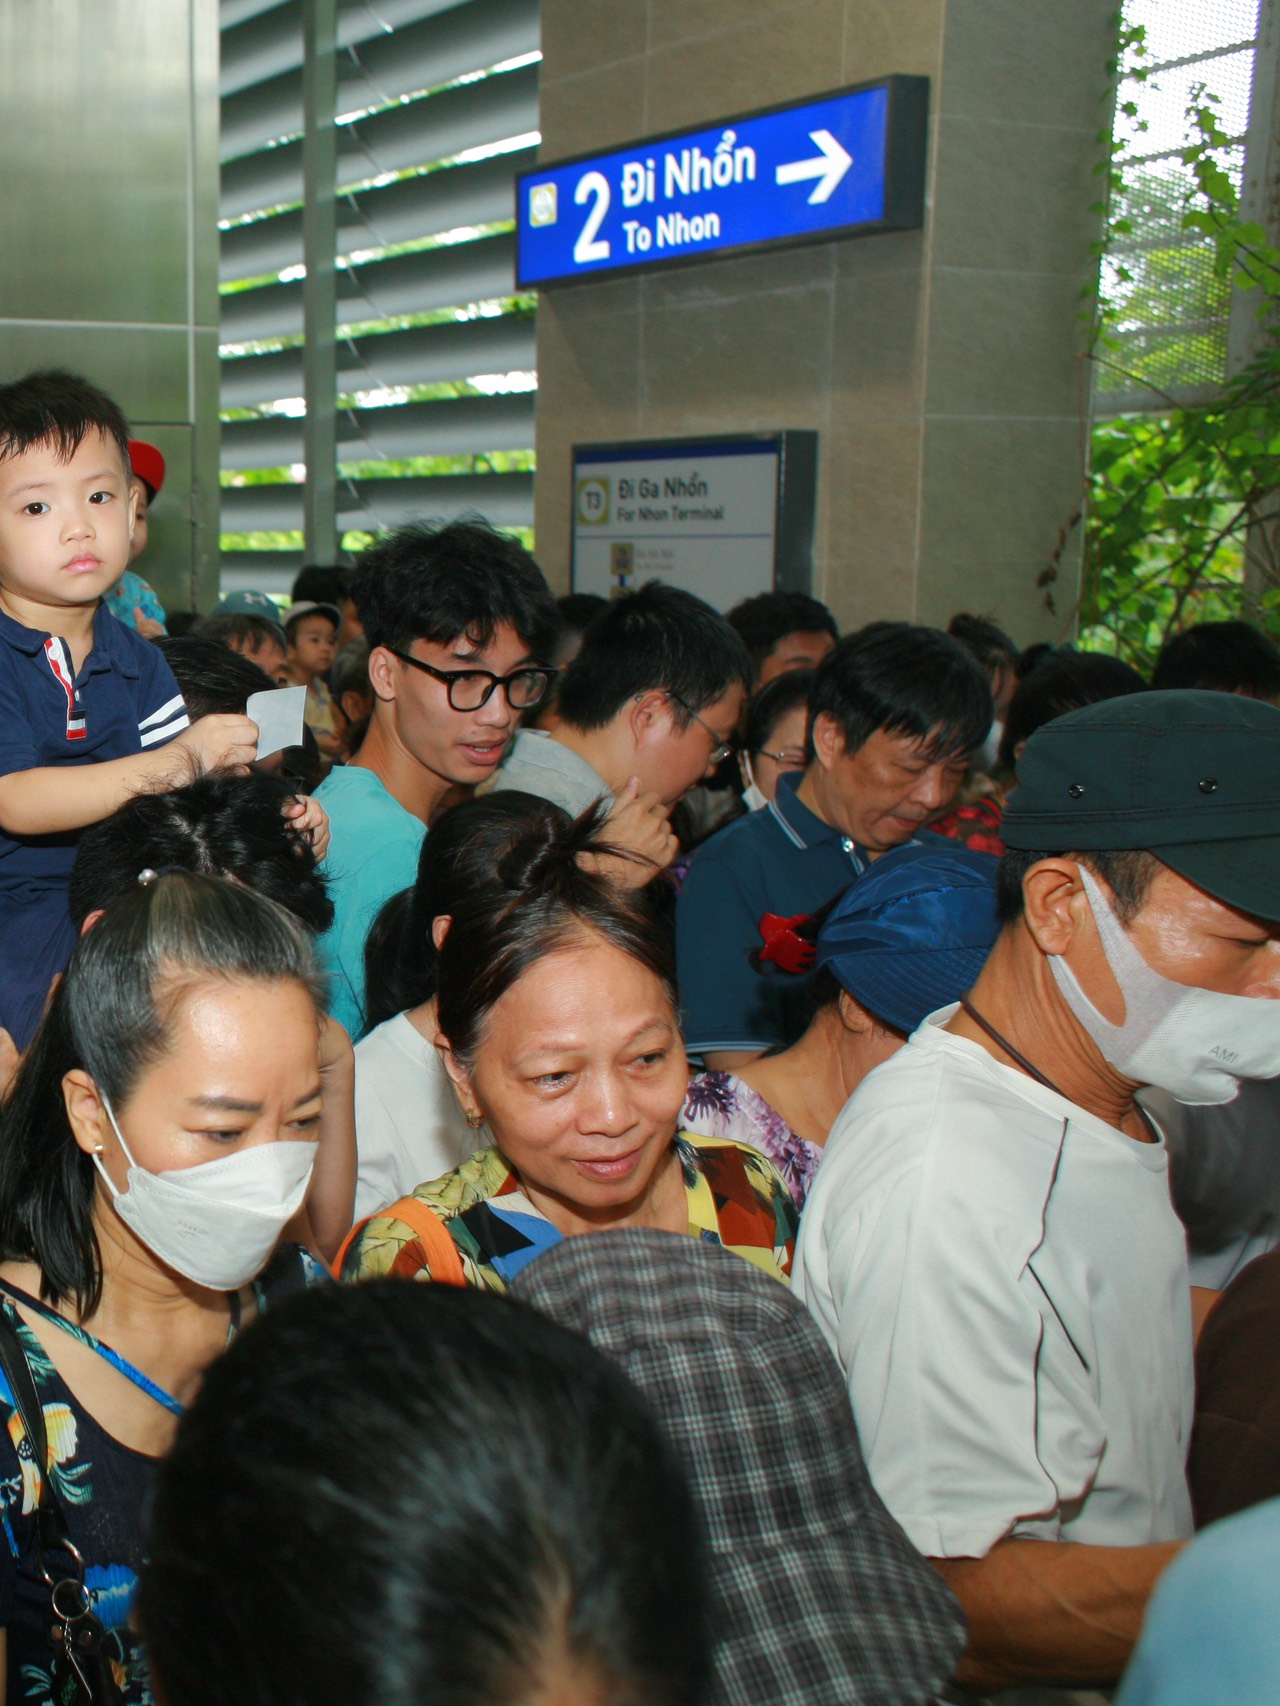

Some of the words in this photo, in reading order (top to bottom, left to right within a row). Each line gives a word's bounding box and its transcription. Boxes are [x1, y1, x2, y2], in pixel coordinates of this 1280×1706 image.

[620, 158, 655, 208] Đi
[664, 129, 757, 199] Nhổn
[573, 171, 611, 264] 2
[623, 221, 652, 253] To
[656, 211, 720, 248] Nhon
[619, 478, 634, 499] Đi
[639, 478, 660, 499] Ga
[585, 491, 601, 510] T3
[617, 507, 635, 521] For
[638, 507, 668, 520] Nhon
[672, 505, 724, 520] Terminal
[1208, 1045, 1239, 1064] AMI
